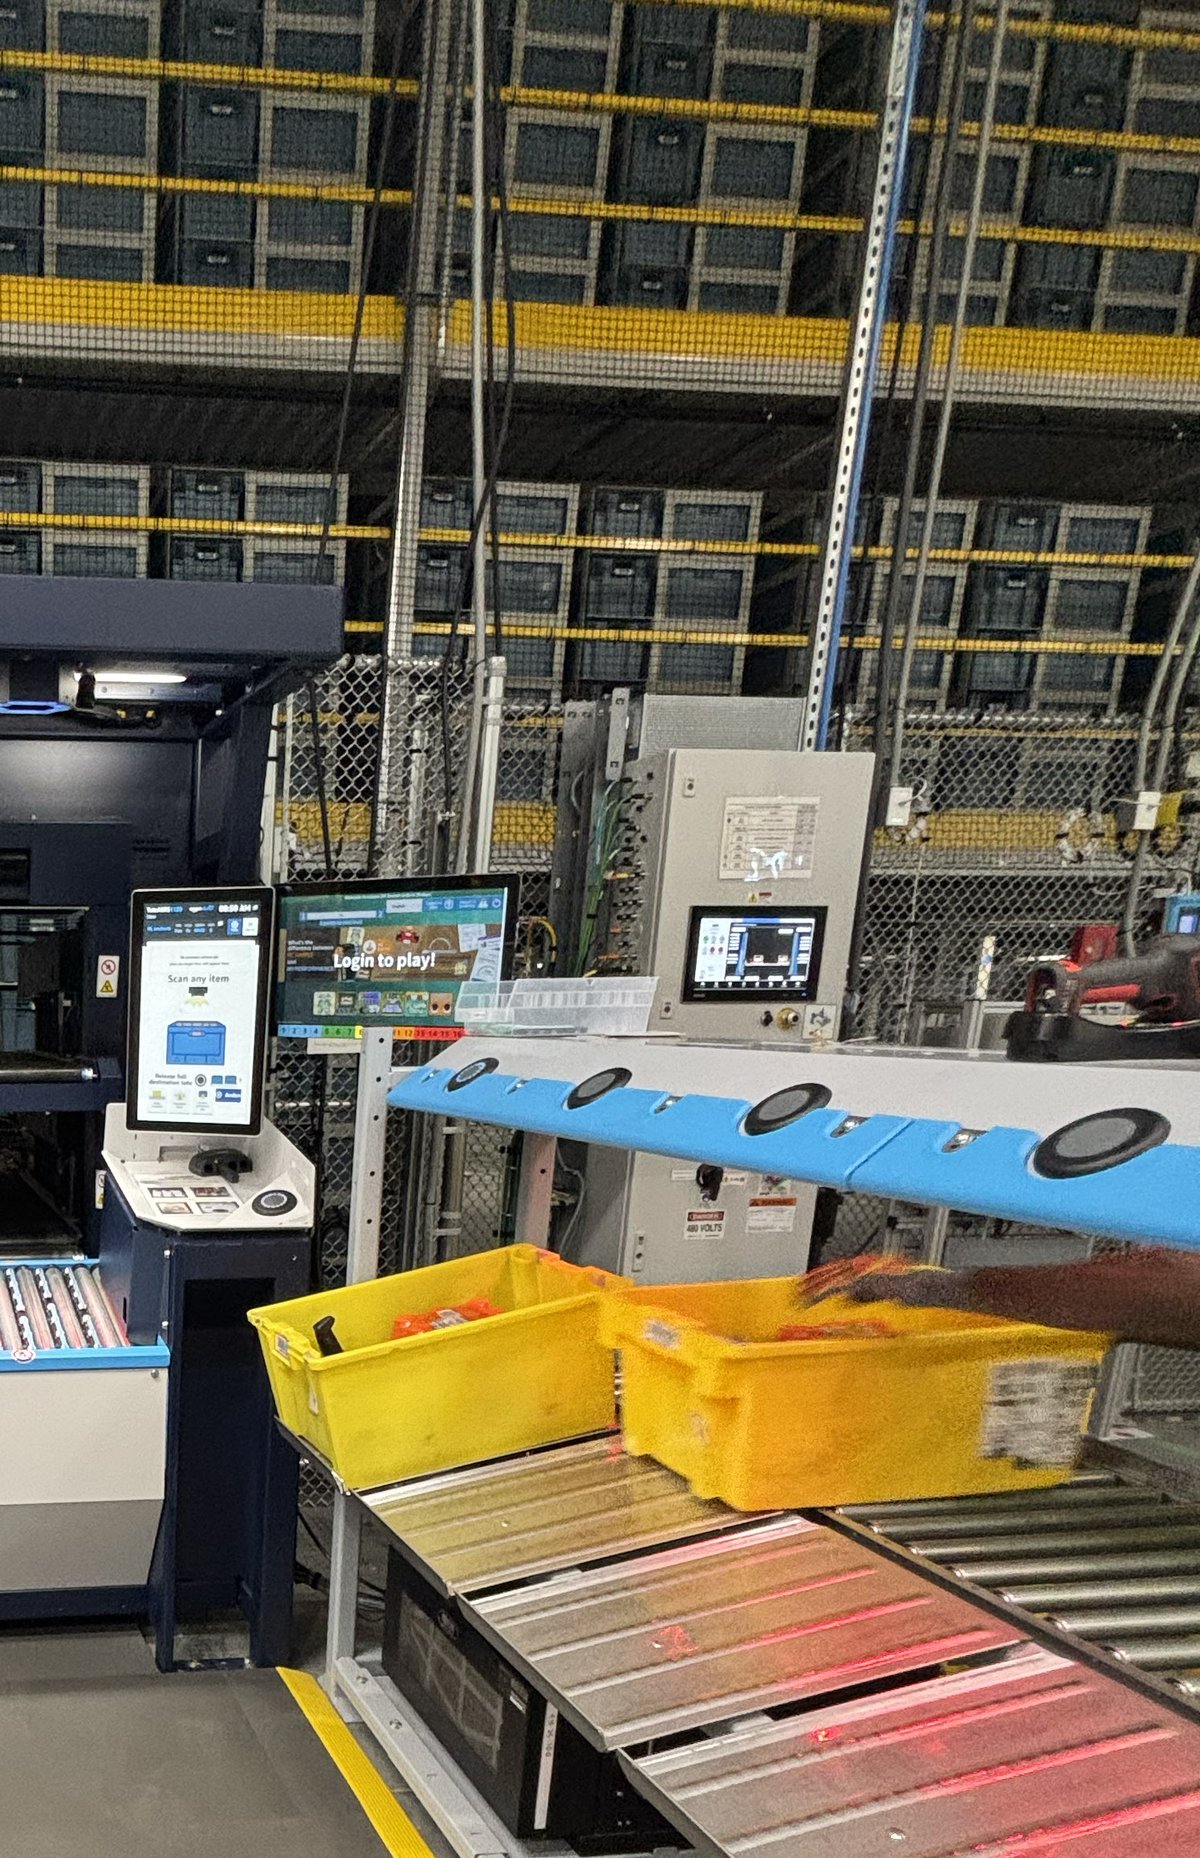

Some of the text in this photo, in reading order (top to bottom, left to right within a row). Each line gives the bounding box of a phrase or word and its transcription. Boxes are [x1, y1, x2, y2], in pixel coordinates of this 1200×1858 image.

[333, 951, 436, 972] Login to play!
[167, 973, 230, 984] Scan any item
[686, 1223, 722, 1232] 480 VOLTS
